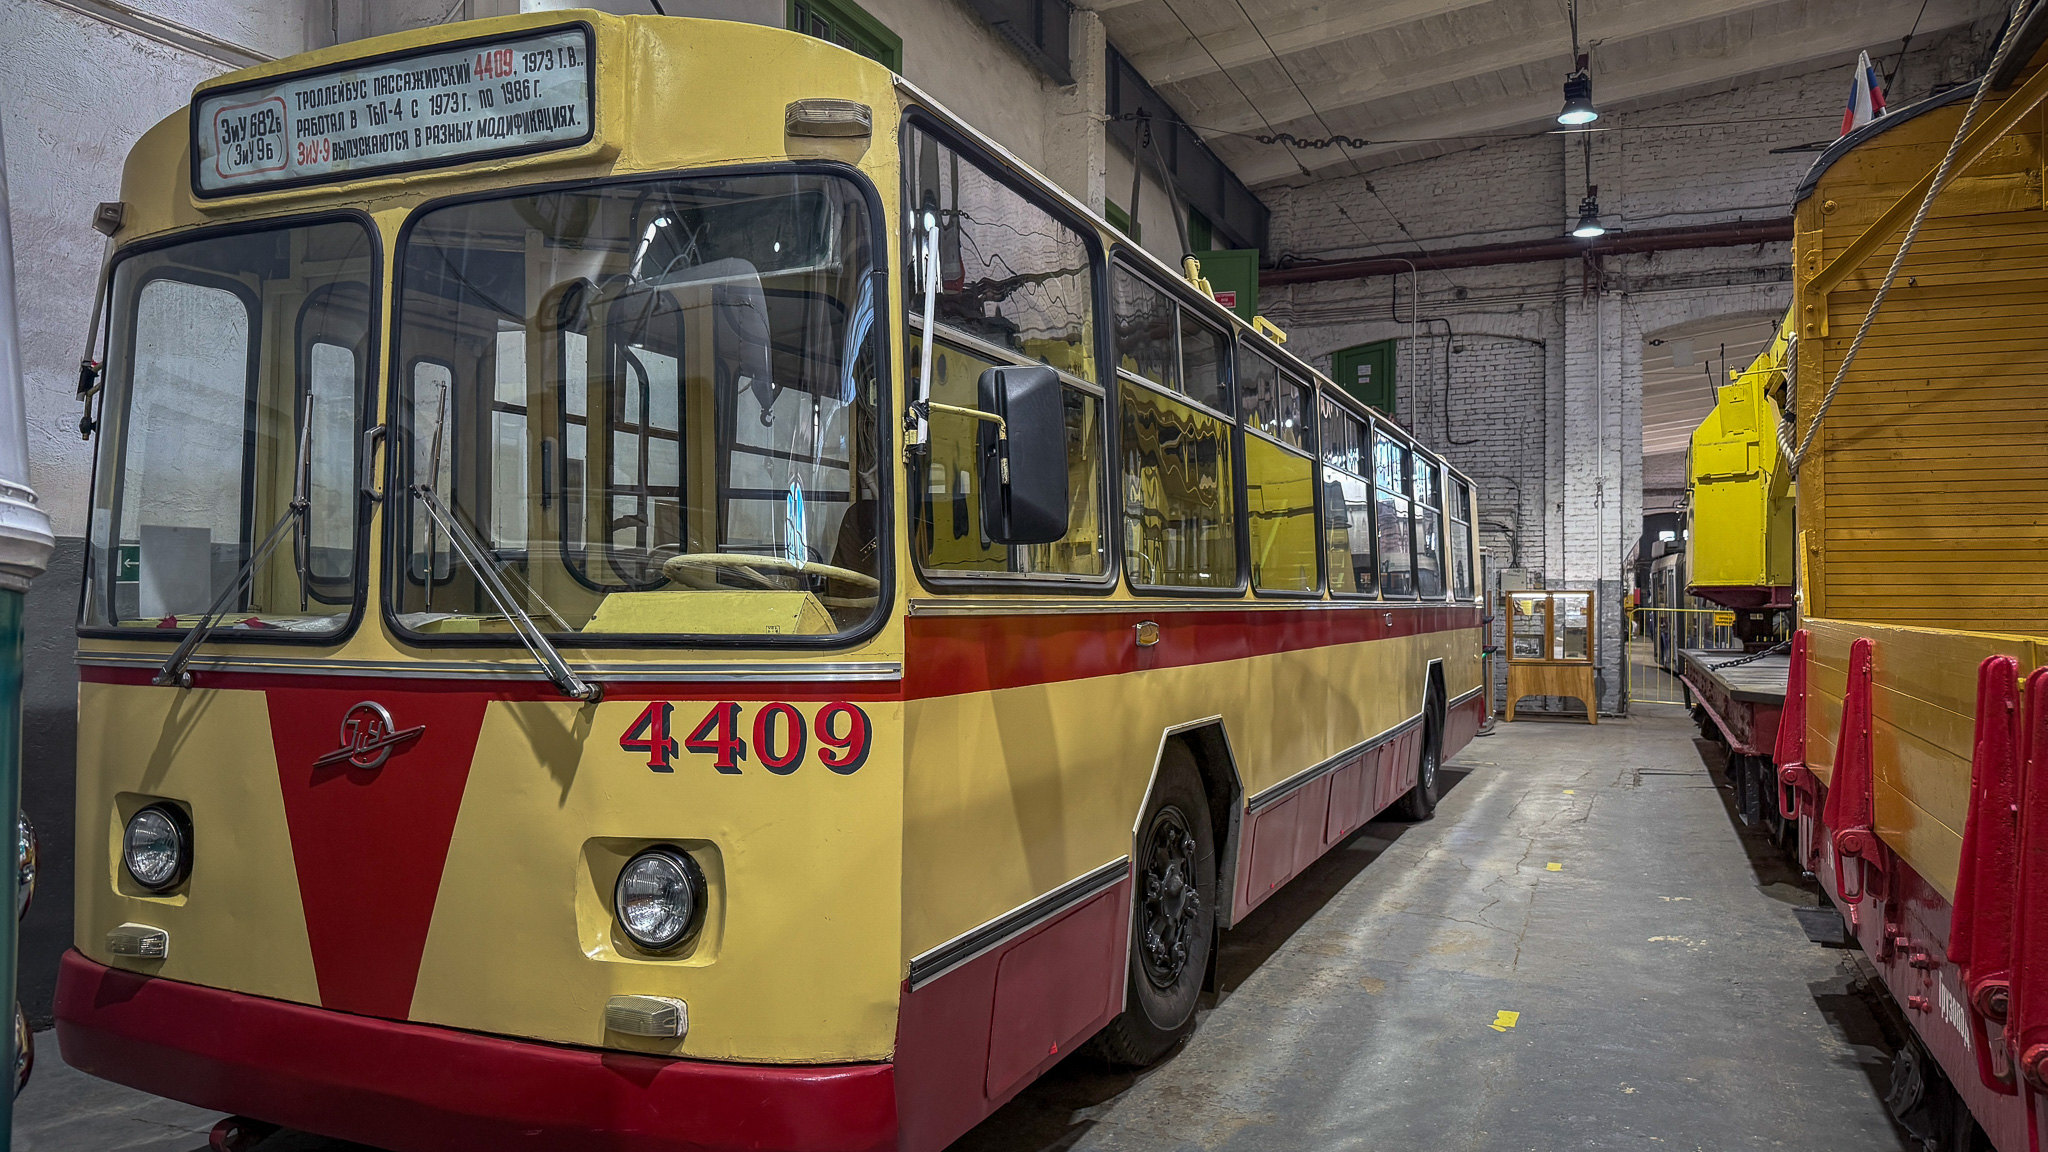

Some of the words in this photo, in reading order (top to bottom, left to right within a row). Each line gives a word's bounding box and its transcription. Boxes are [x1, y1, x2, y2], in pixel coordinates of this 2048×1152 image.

[295, 79, 367, 111] ТРОЛЛЕЙБУС
[373, 57, 471, 97] ПАССАЖИРСКИЙ
[522, 49, 554, 74] 1973
[296, 111, 345, 139] РАБОТАЛ
[349, 109, 358, 130] В
[411, 98, 419, 119] С
[428, 91, 460, 116] 1973
[478, 88, 494, 109] ПО
[500, 79, 531, 105] 1986
[331, 129, 410, 162] ВЫПУСКАЮТСЯ
[414, 127, 422, 148] В
[424, 120, 474, 146] РАЗНЫХ
[476, 104, 581, 140] МОДИФИКАЦИЯХ.
[619, 701, 874, 777] 4409
